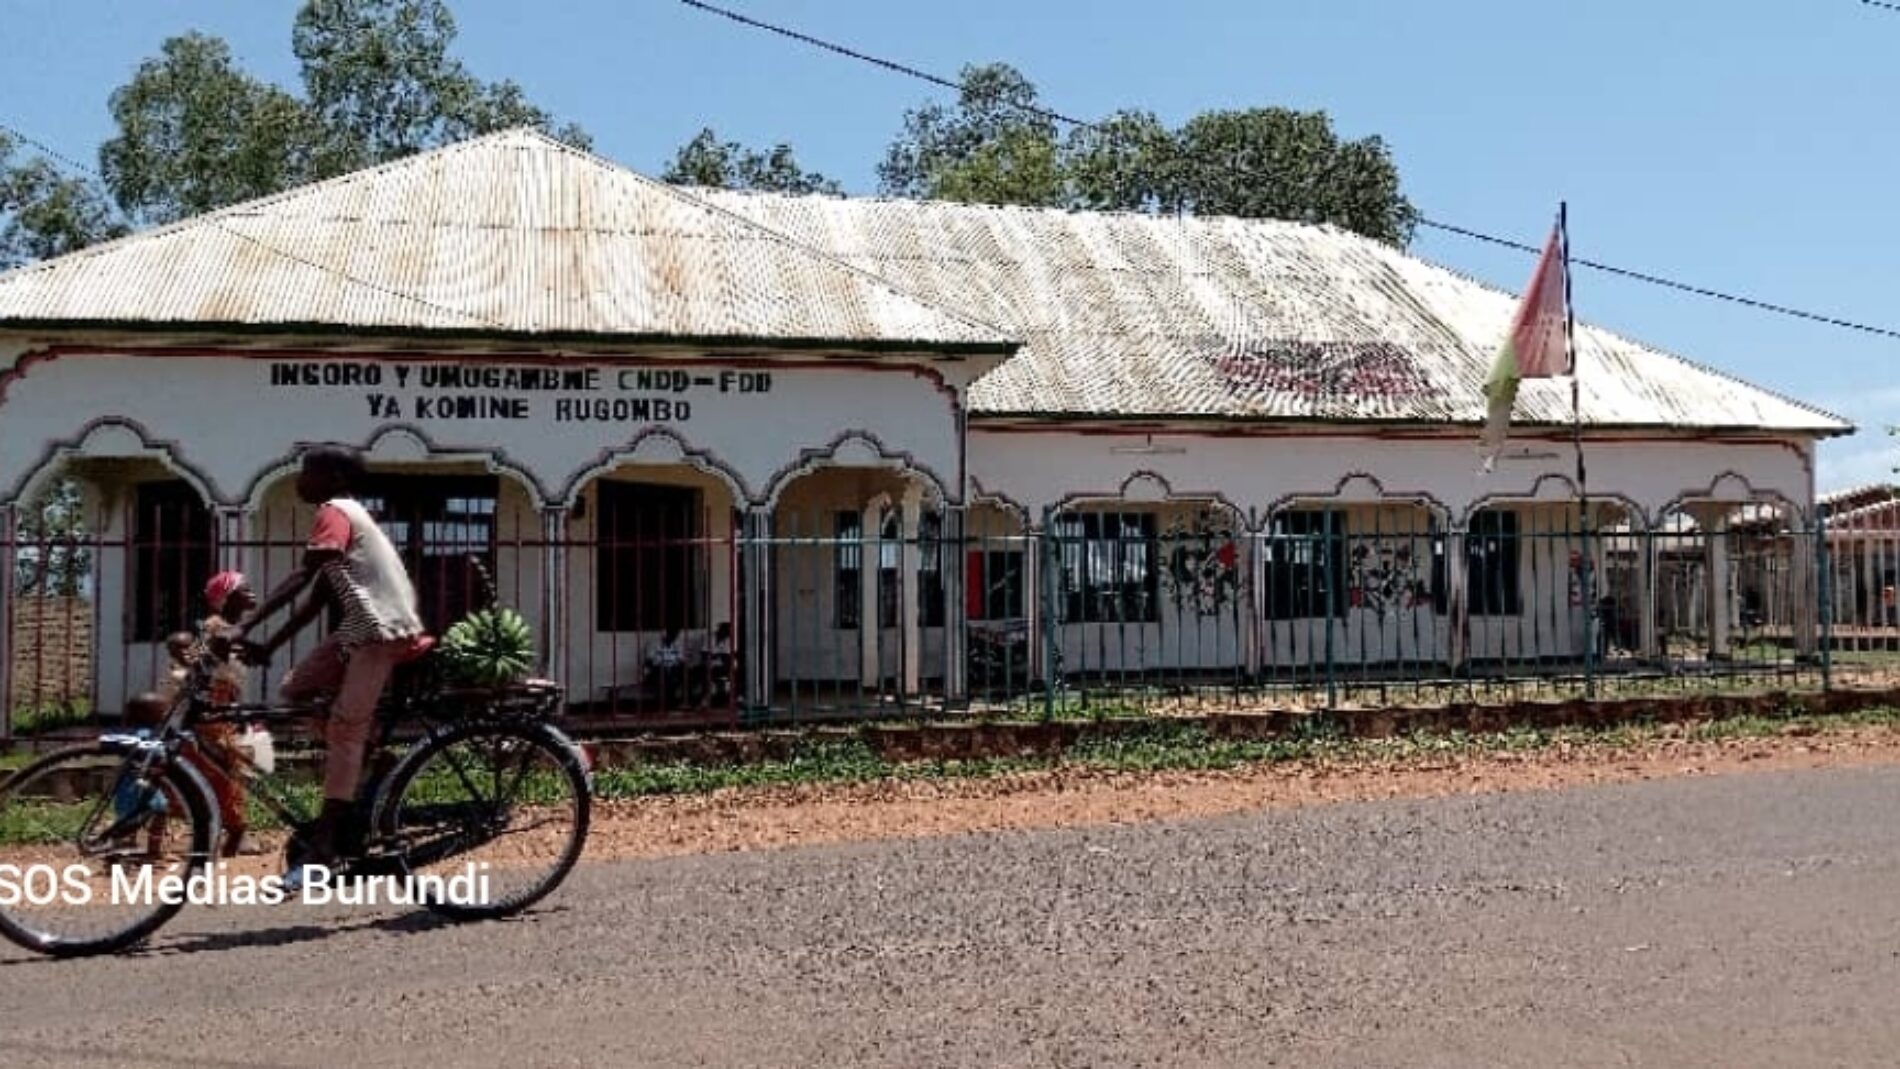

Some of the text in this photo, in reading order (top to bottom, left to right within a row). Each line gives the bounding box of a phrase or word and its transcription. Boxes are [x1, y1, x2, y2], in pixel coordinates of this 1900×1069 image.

[366, 393, 692, 422] YA KOMINE RUGOMBO
